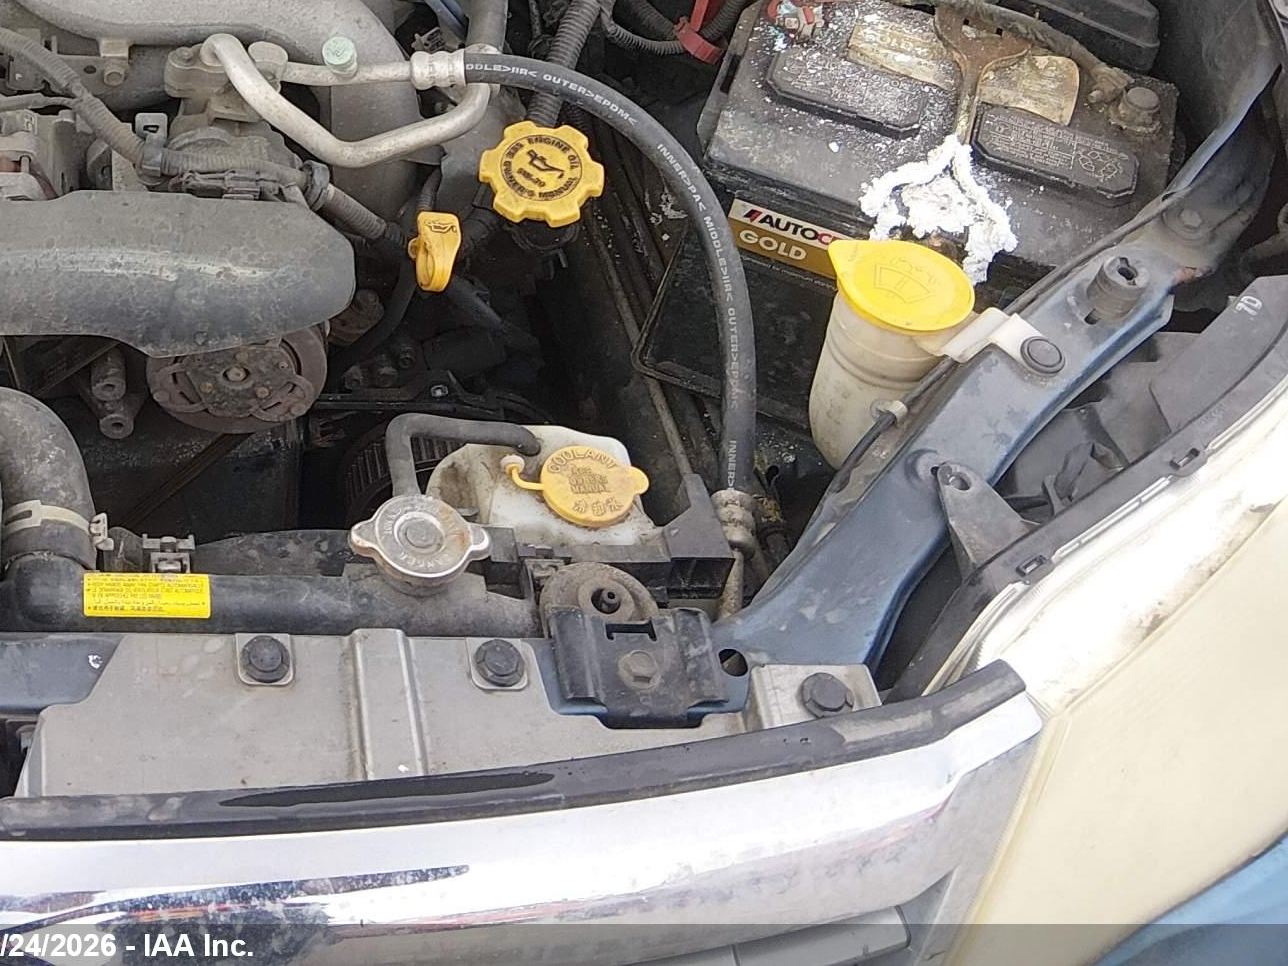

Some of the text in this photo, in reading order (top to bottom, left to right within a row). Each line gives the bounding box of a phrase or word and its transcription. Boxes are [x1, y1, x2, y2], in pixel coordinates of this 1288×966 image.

[527, 136, 580, 170] ENGINE OIL
[740, 229, 807, 261] GOLD
[760, 213, 838, 246] AUTOC
[465, 62, 538, 79] DDLE>IIR<
[726, 440, 737, 491] INNER>
[547, 448, 617, 474] COOLANT
